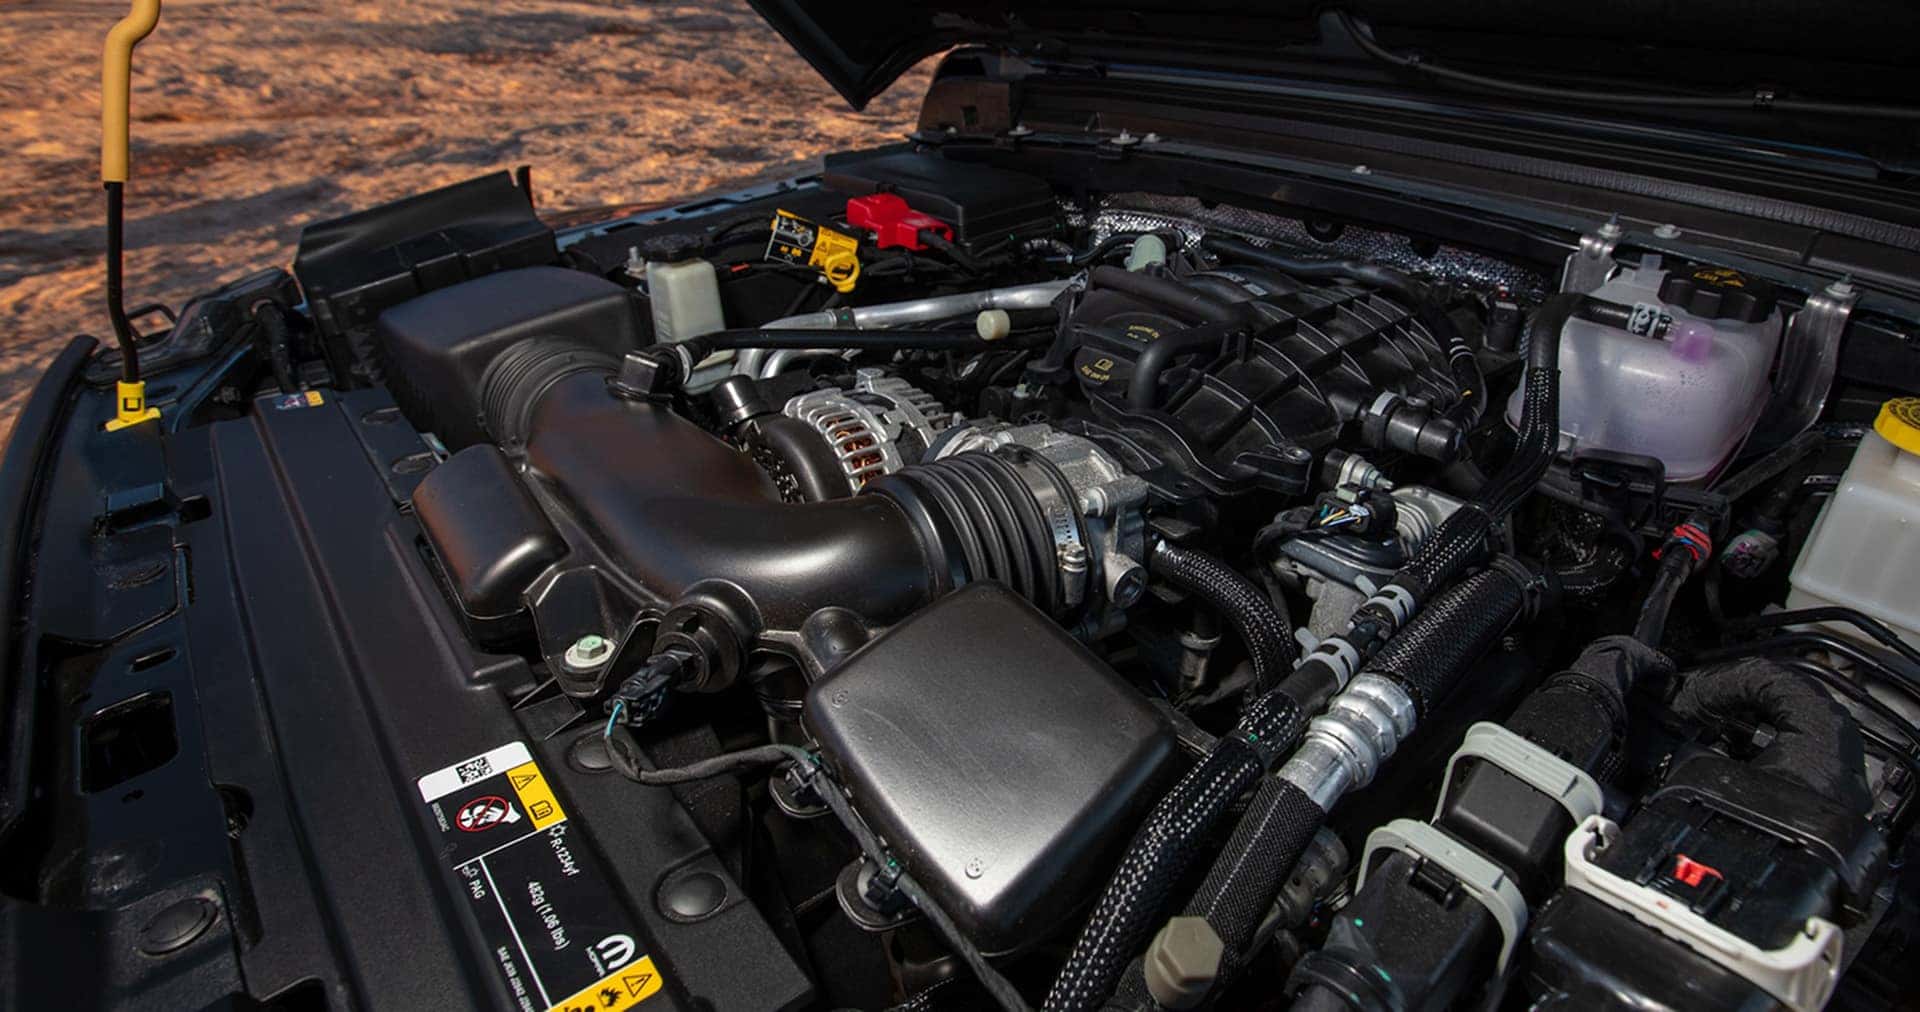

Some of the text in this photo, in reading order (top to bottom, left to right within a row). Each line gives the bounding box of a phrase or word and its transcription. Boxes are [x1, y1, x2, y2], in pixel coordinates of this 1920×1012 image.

[551, 838, 580, 877] R-1234yf
[468, 879, 486, 900] PAG
[527, 881, 570, 951] 482g (1.06 lbs)
